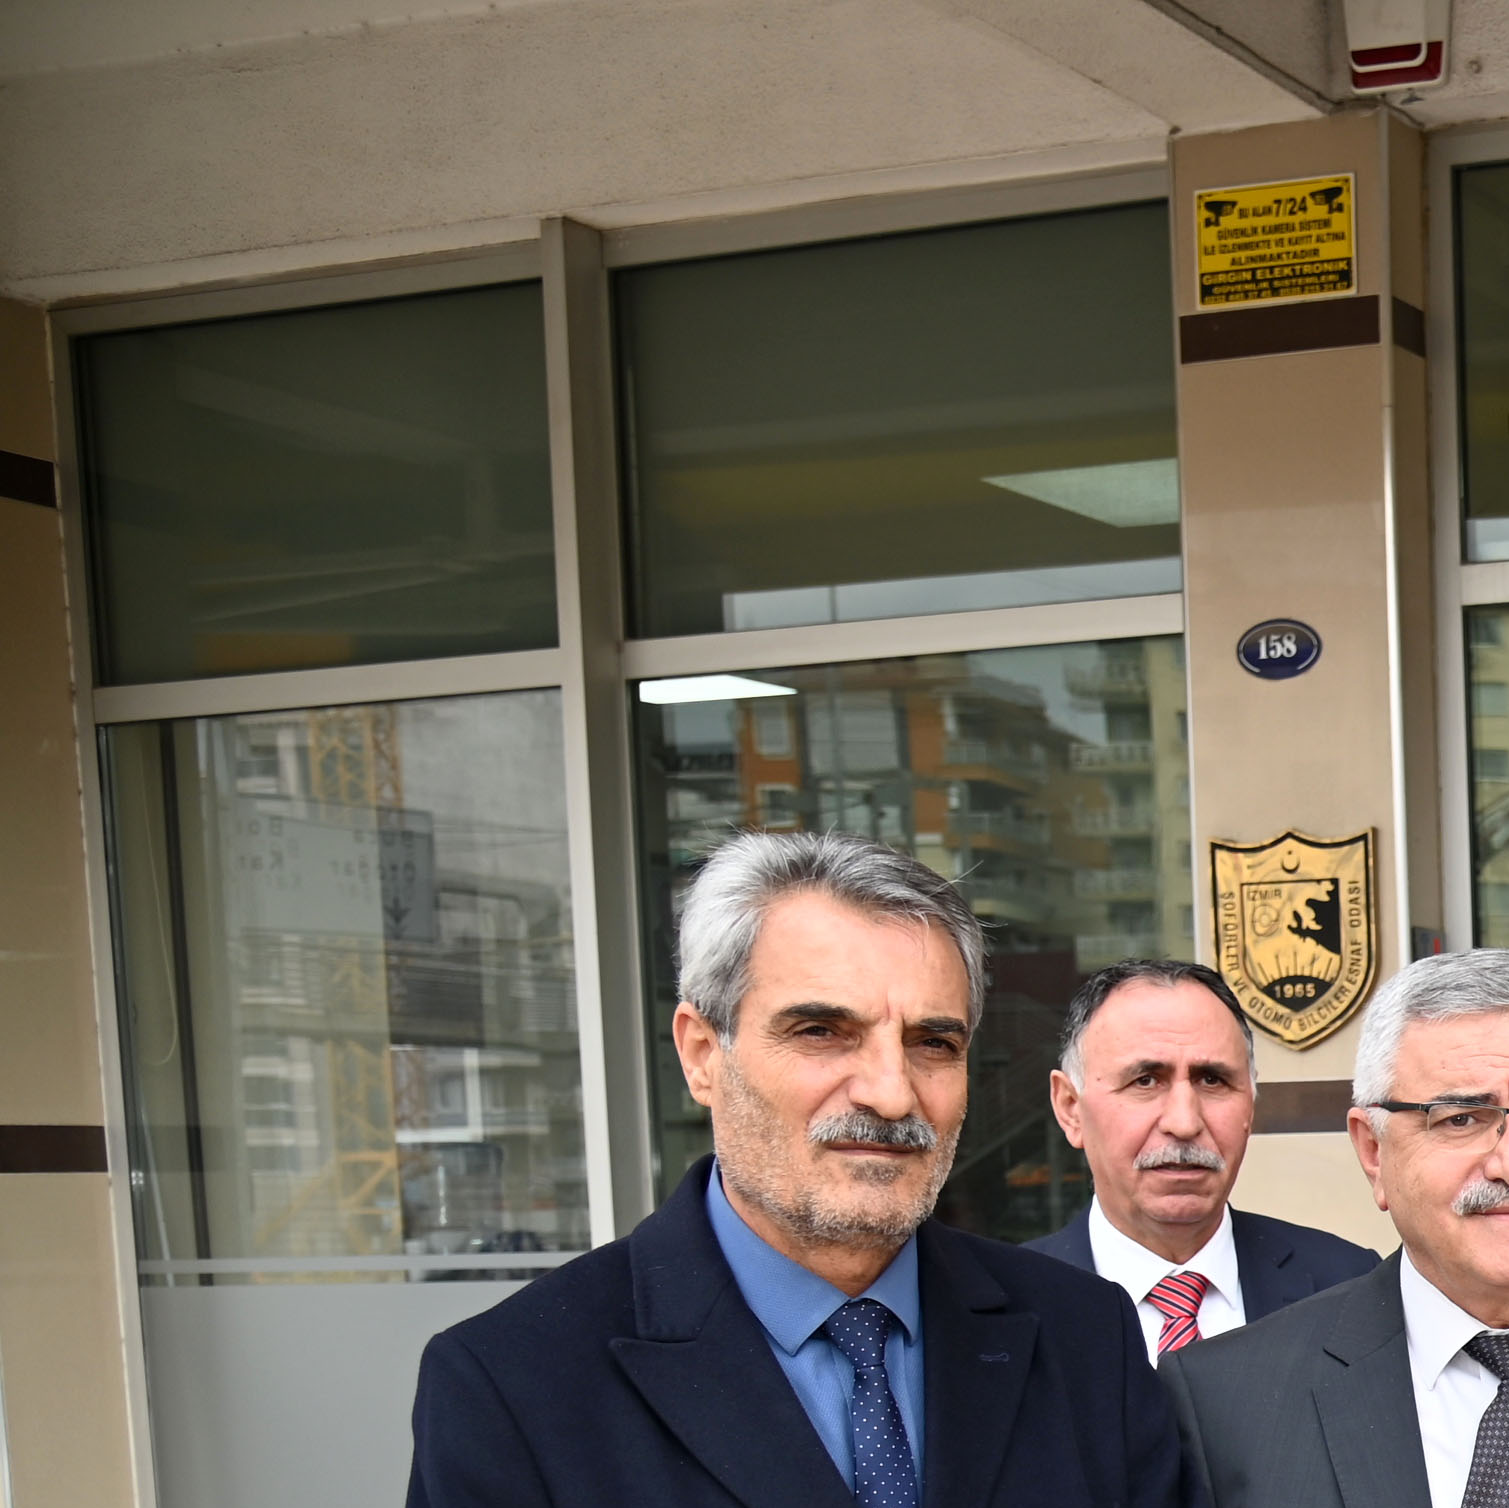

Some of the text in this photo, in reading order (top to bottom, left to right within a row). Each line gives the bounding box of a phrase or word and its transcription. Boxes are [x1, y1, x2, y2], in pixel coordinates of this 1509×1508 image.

[1273, 197, 1308, 218] 7/24
[1217, 217, 1332, 240] GÜVENLİK KAMERA SİSTEMİ
[1274, 238, 1285, 249] VE
[1287, 233, 1313, 248] KAYIT
[1315, 231, 1346, 244] ALTINA
[1230, 248, 1320, 267] ALINMAKTADIR
[1258, 633, 1298, 660] 158
[1247, 888, 1282, 902] İZMİR
[1347, 880, 1362, 928] ODASI
[1346, 938, 1362, 985] ESNAF
[1234, 978, 1247, 994] VE
[1274, 982, 1316, 998] 1965
